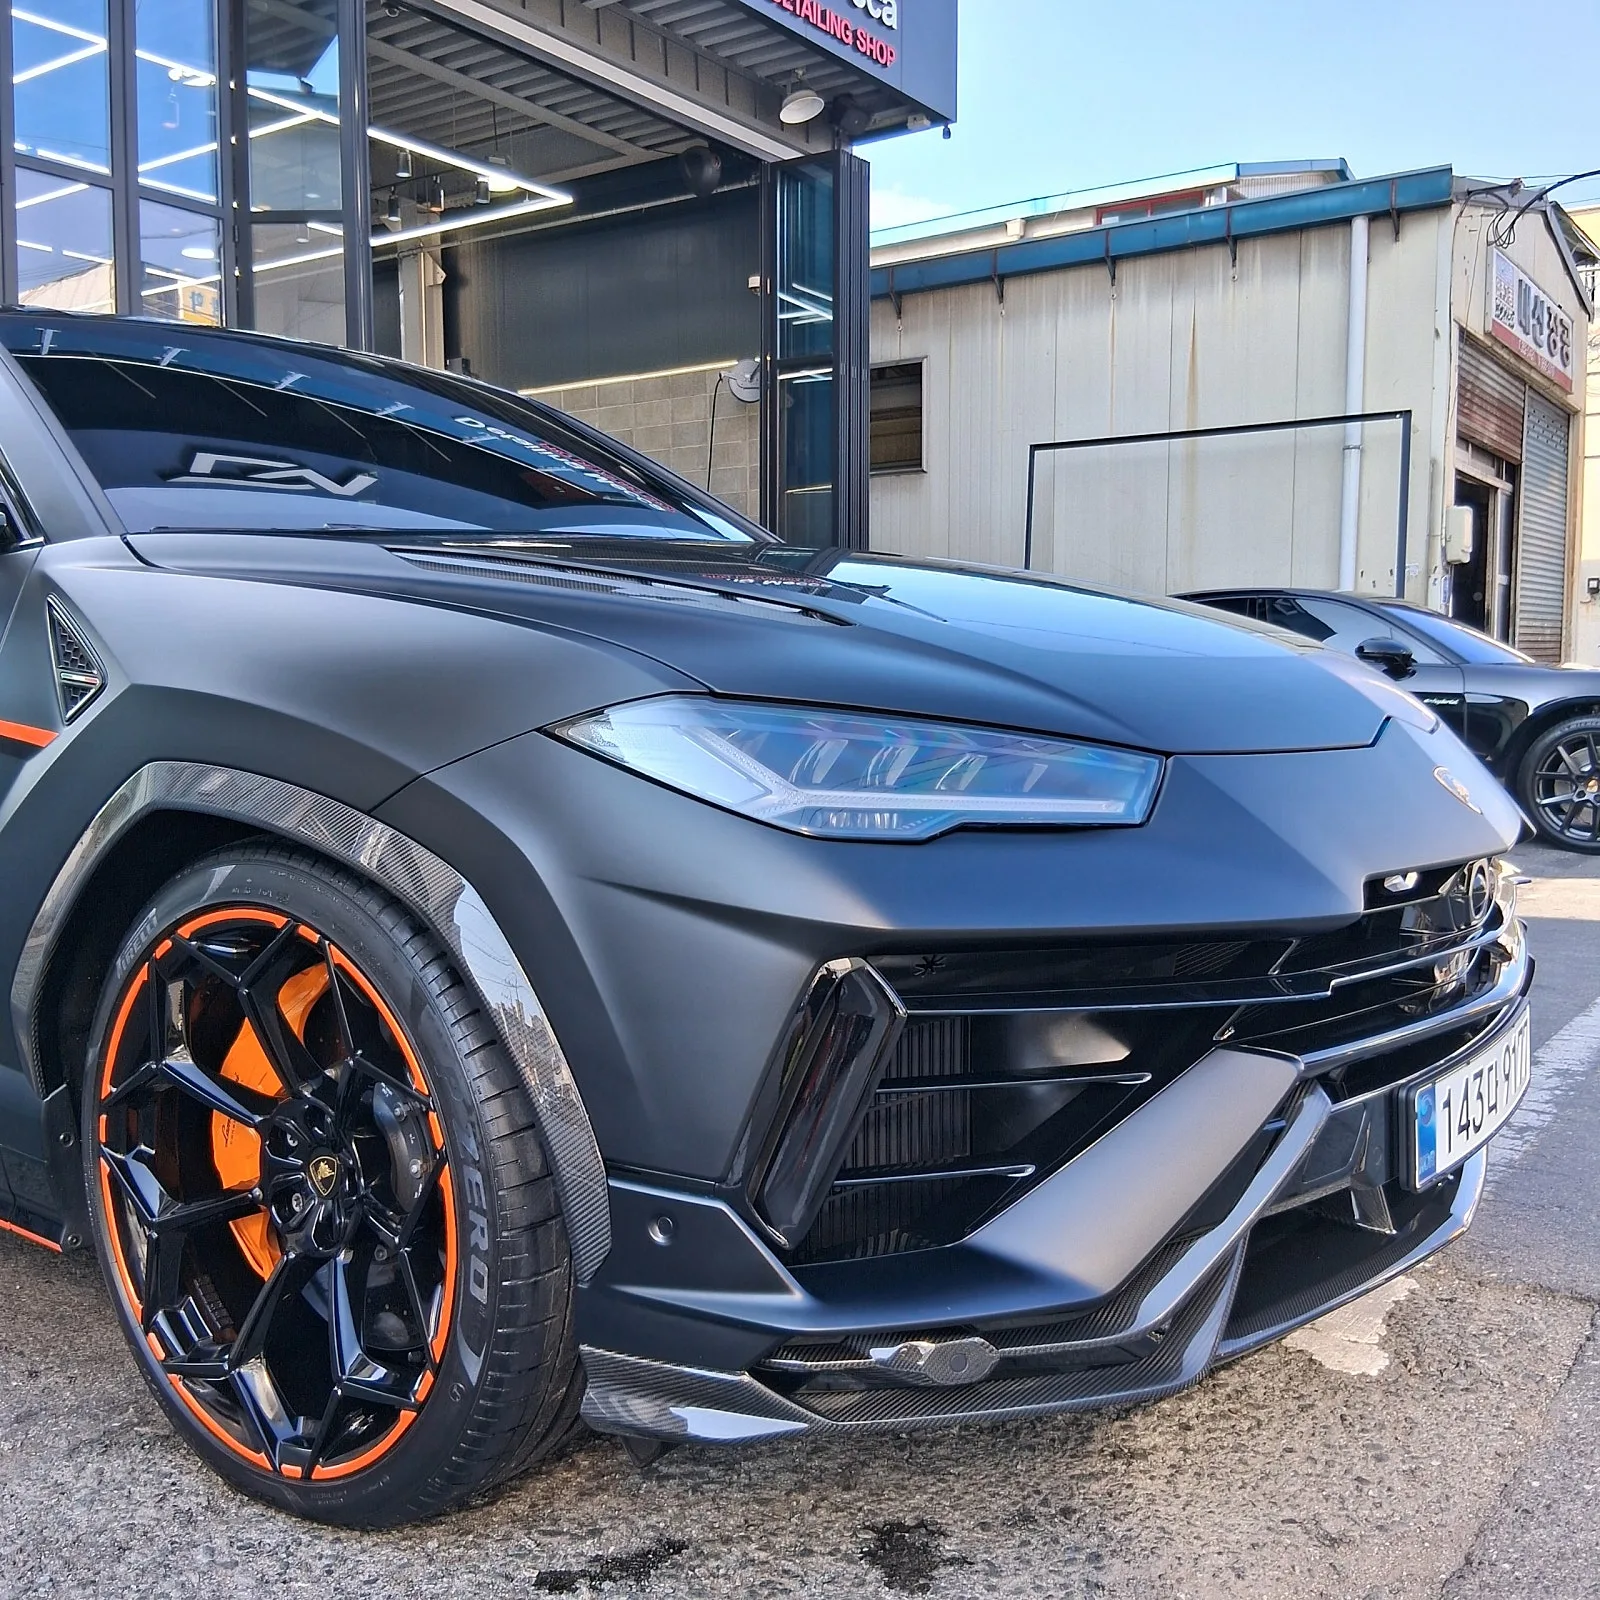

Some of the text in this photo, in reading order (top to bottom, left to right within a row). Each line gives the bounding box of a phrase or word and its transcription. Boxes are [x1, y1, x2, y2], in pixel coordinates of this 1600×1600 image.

[771, 0, 896, 68] TAILING SHOP
[1502, 1021, 1528, 1105] 9177
[452, 1118, 489, 1306] ZERO
